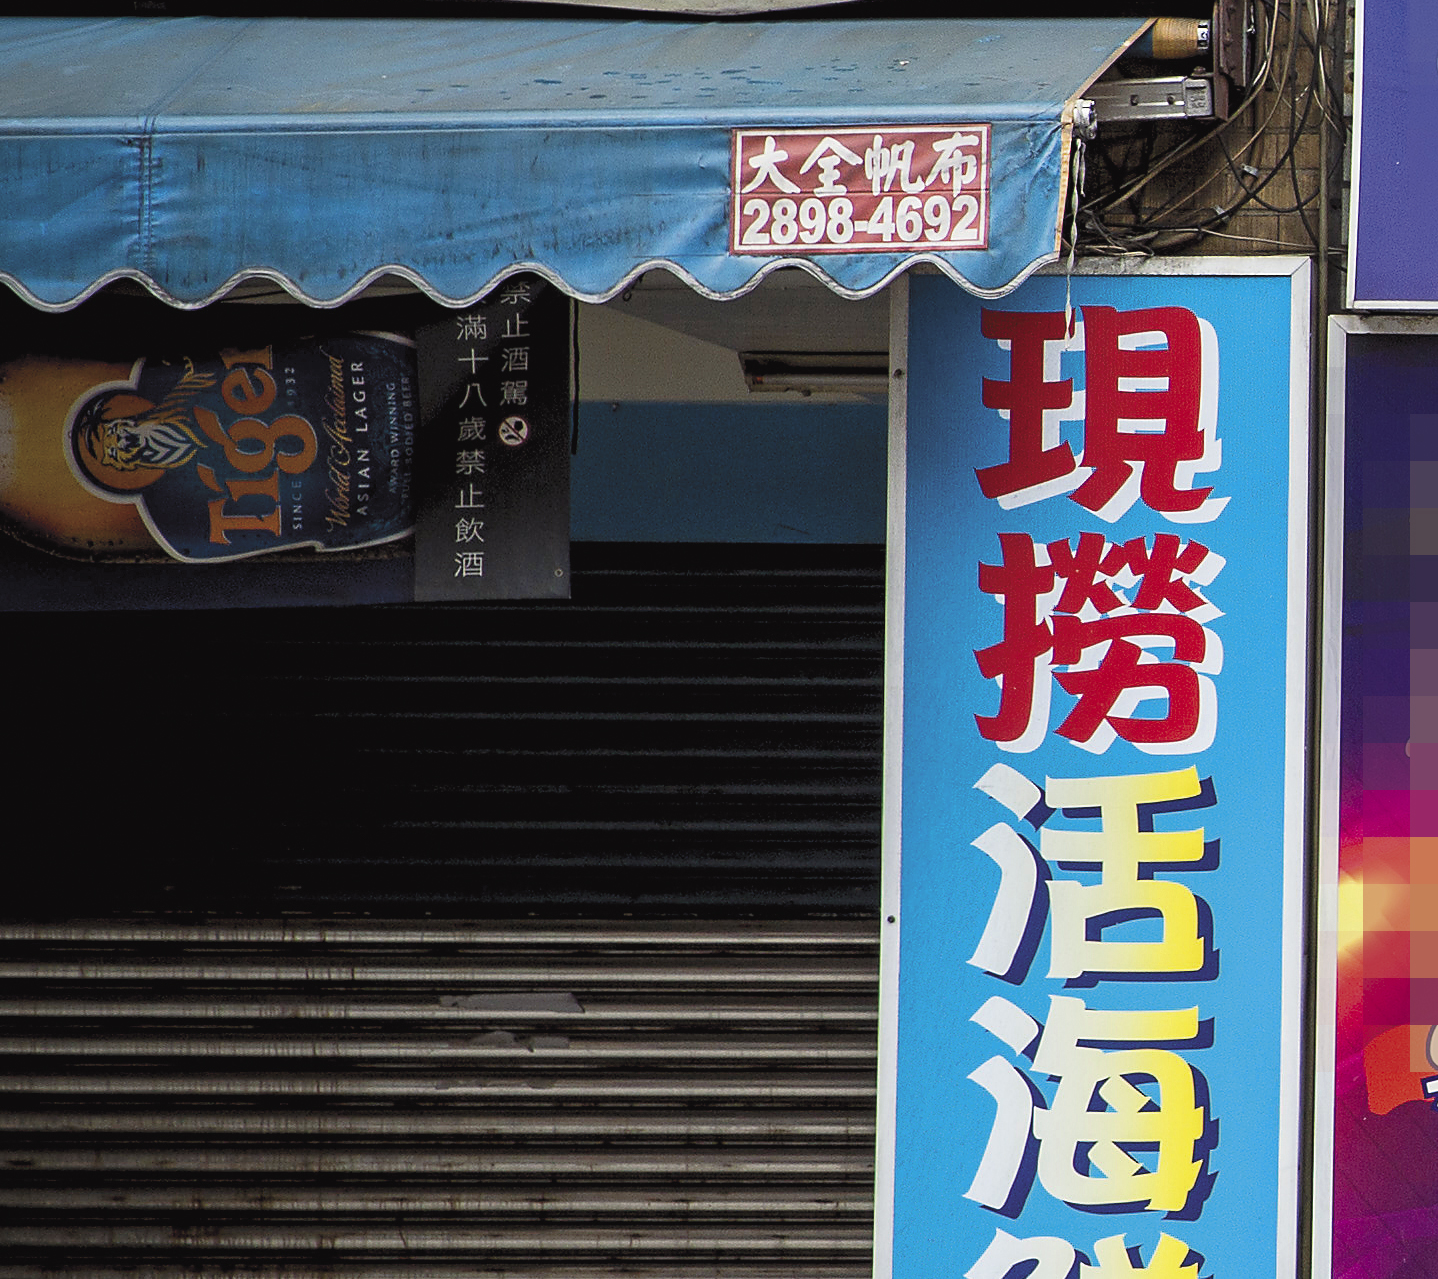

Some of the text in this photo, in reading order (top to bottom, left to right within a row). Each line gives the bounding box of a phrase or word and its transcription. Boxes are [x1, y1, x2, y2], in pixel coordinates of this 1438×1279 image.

[741, 132, 980, 198] 大全帆布
[741, 194, 979, 245] 2898-4692
[193, 344, 318, 545] Tiger
[350, 361, 371, 516] ASIAN LAGER
[454, 299, 489, 578] 滿十八歲禁止飲酒
[291, 480, 303, 531] SINCE
